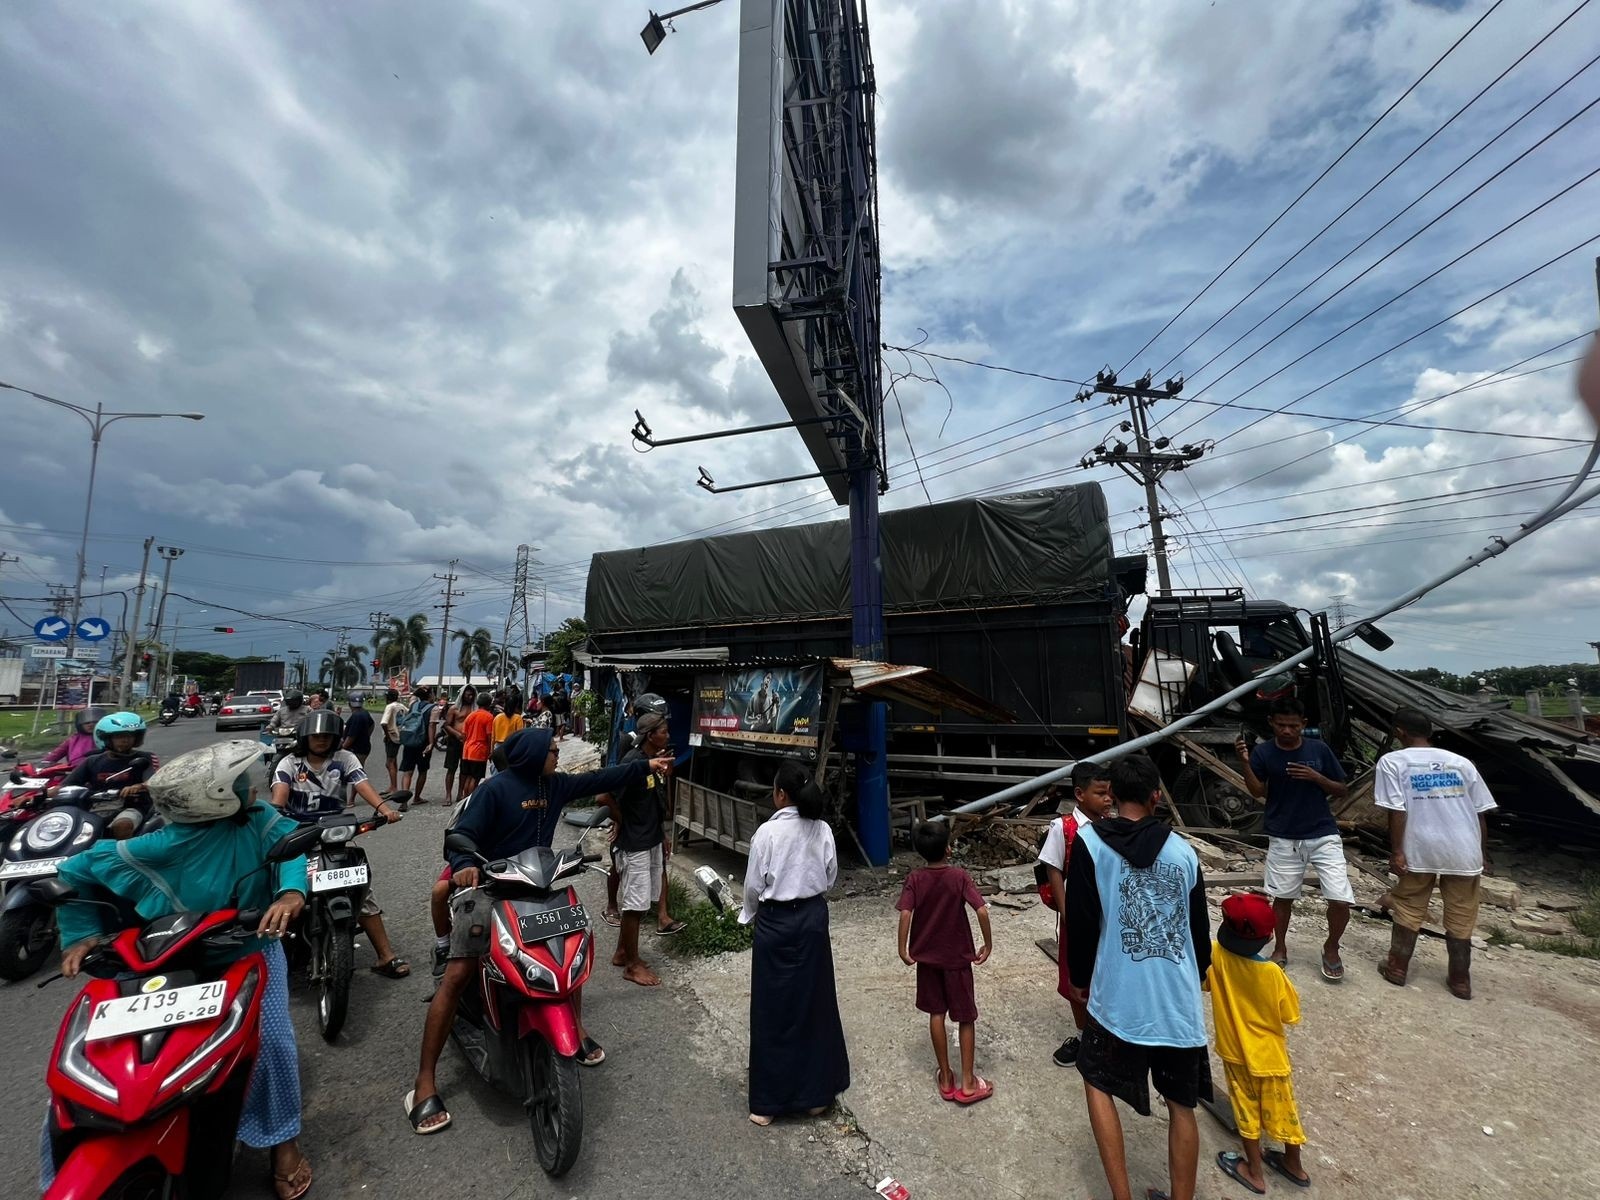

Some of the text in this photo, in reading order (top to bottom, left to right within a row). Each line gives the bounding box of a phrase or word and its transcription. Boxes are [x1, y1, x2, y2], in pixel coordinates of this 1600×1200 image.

[1432, 763, 1441, 771] 2
[1410, 772, 1459, 782] NGOPENI,
[1411, 780, 1464, 789] NGLAKONI
[307, 791, 320, 811] 5
[315, 873, 322, 883] K
[327, 869, 350, 881] 6880
[520, 906, 583, 929] K 5561 SS
[559, 919, 586, 931] 10 25
[95, 984, 223, 1020] K 4139 ZU
